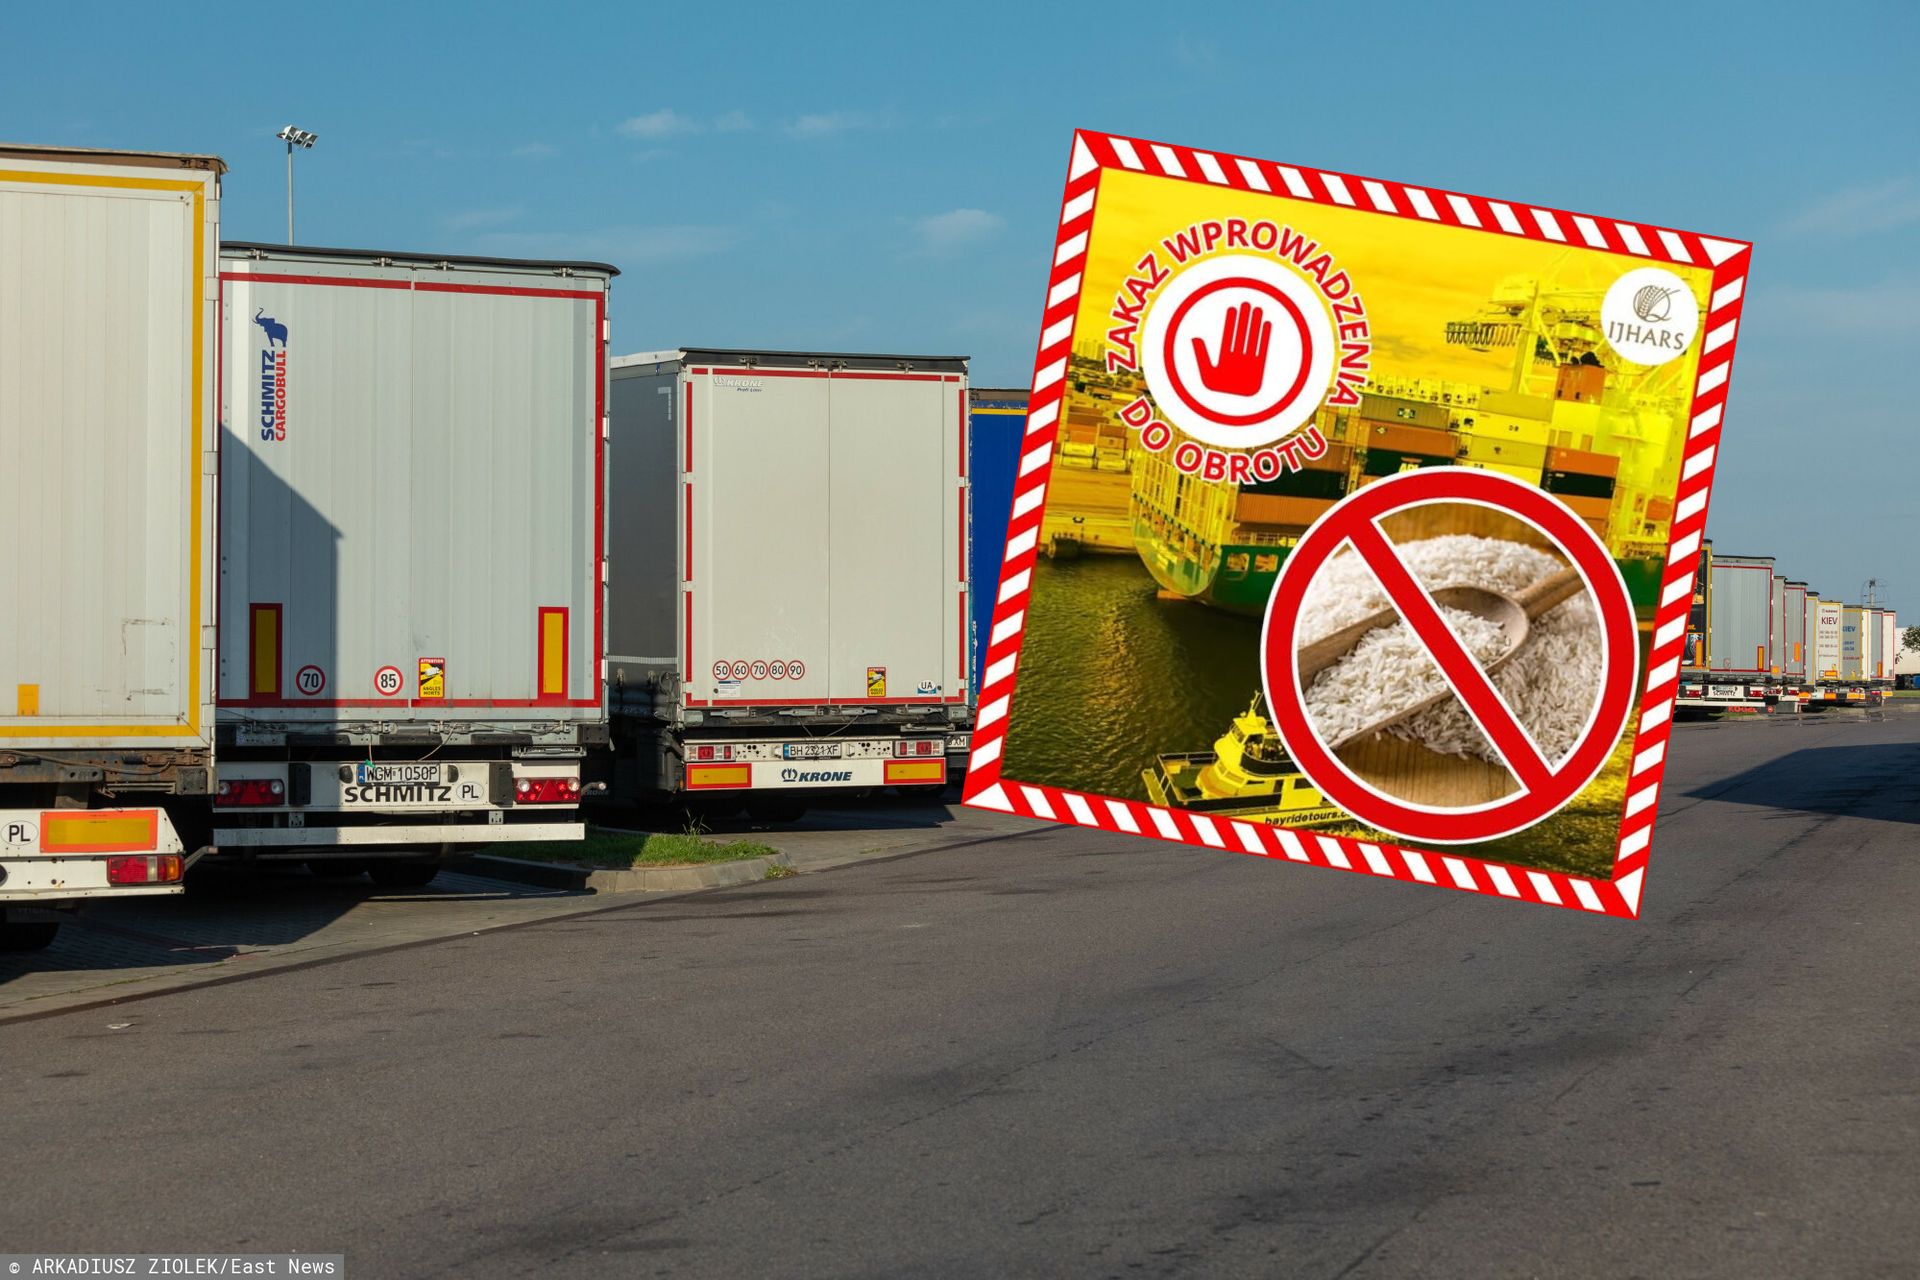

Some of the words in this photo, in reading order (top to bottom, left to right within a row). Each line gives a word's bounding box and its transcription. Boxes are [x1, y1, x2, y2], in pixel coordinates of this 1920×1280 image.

[261, 350, 275, 441] SCHMITZ
[275, 350, 286, 441] CARGOBULL
[716, 665, 728, 675] 50
[735, 665, 746, 675] 60
[754, 665, 765, 675] 70
[771, 665, 783, 675] 80
[790, 665, 802, 675] 90
[303, 673, 319, 688] 70
[380, 673, 397, 688] 85
[921, 681, 933, 689] UA
[790, 746, 803, 755] BH
[366, 766, 393, 780] WGM
[398, 766, 438, 781] 1050P
[798, 771, 853, 783] KRONE
[344, 785, 452, 803] SCHMITZ
[462, 785, 479, 799] PL
[8, 824, 31, 843] PL
